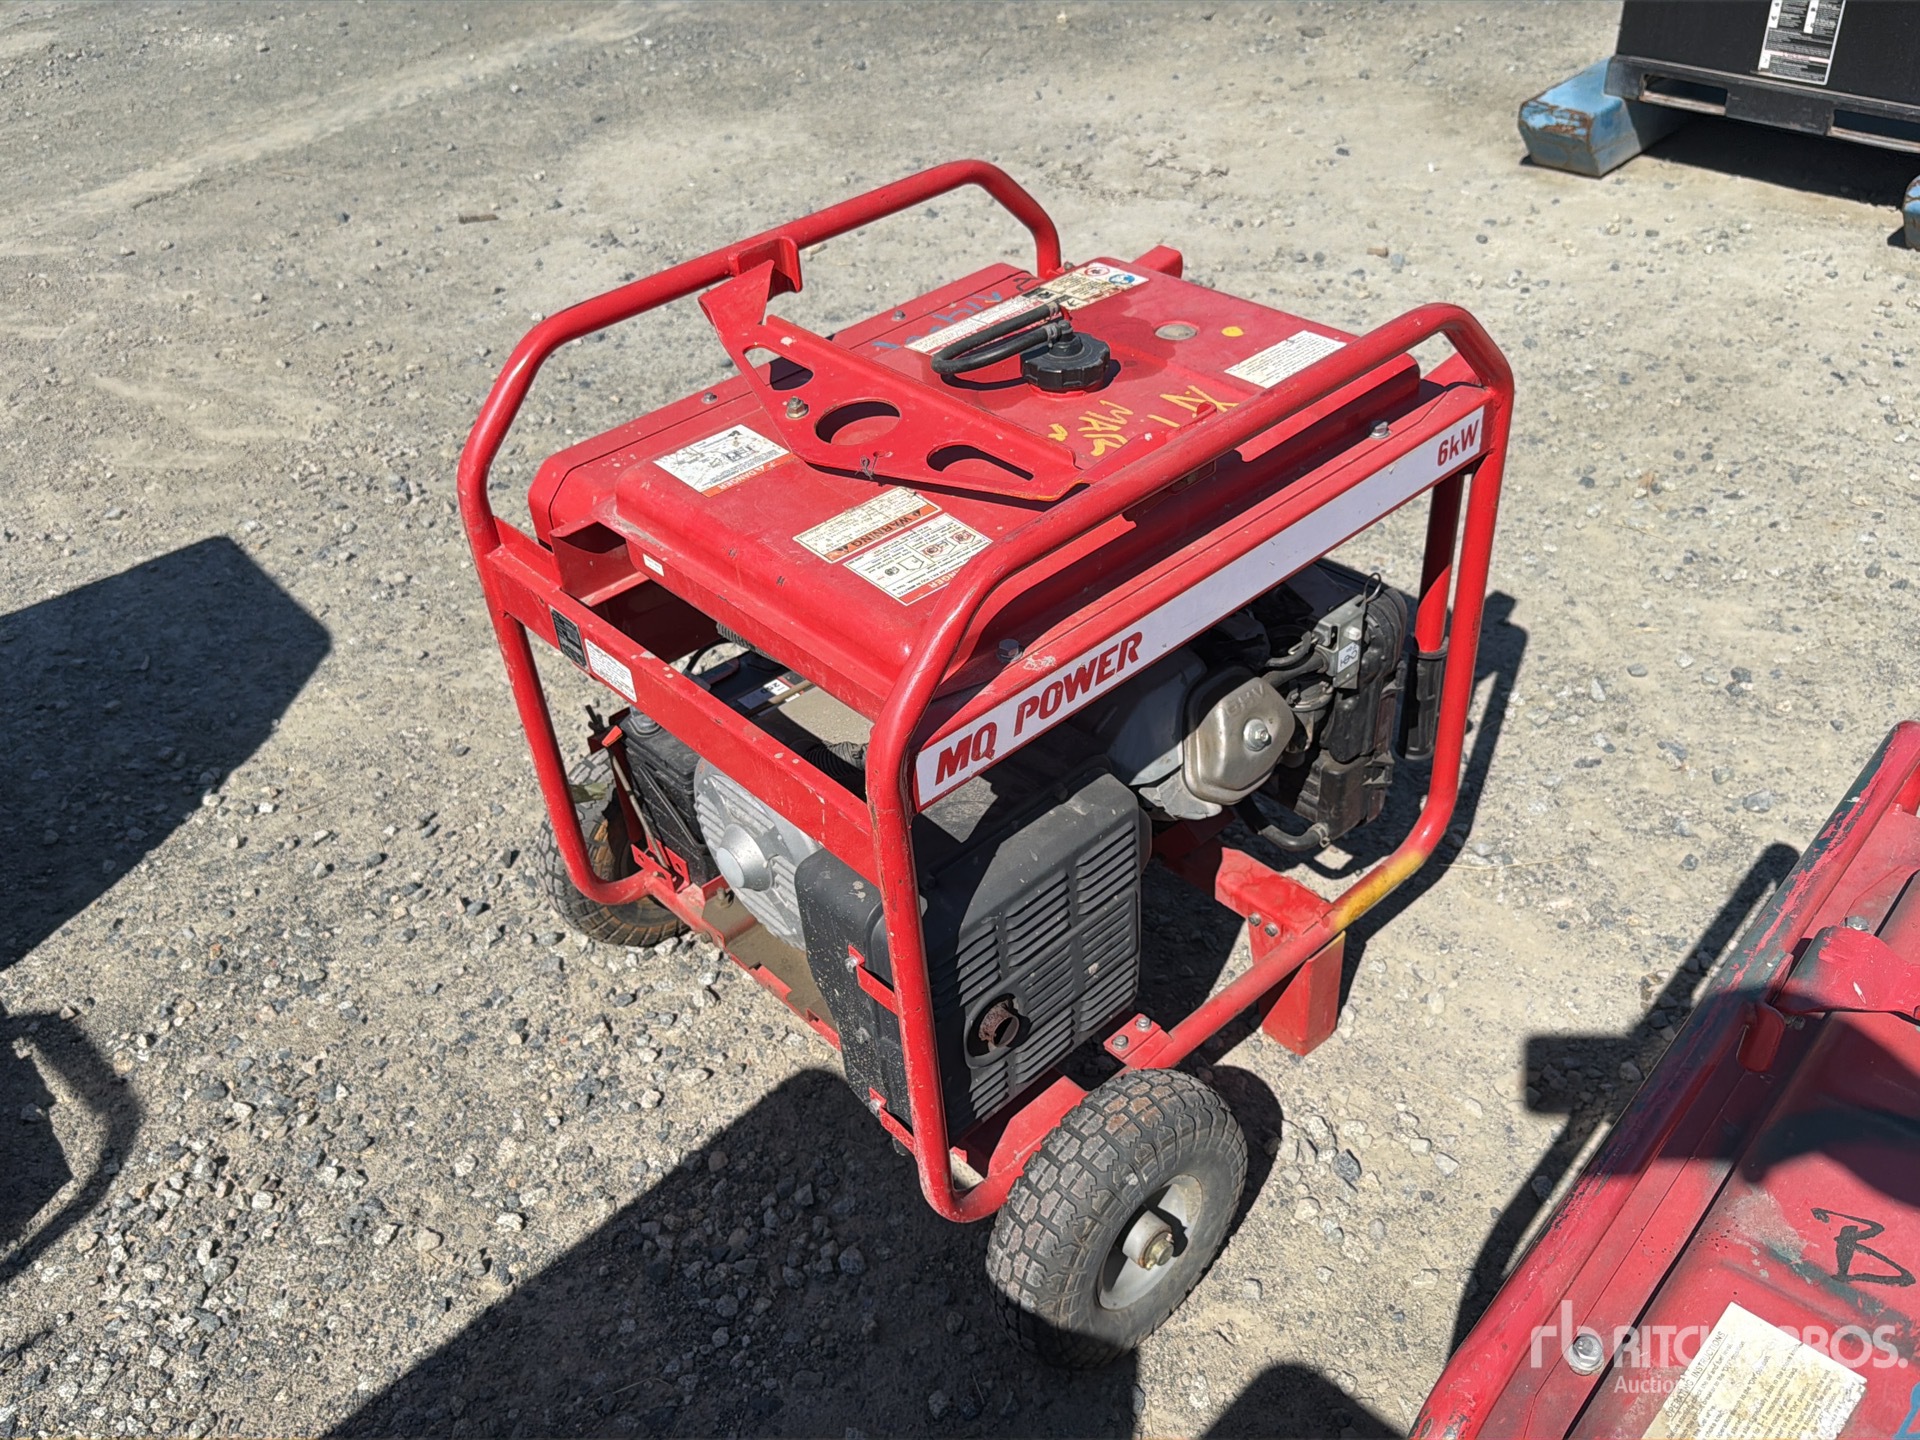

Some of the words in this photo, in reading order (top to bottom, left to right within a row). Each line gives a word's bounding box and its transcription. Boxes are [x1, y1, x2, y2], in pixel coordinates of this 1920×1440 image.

[1437, 419, 1480, 467] 6kW
[851, 510, 913, 548] WARNING
[935, 722, 998, 786] MQ
[1013, 631, 1143, 737] POWER
[1811, 1208, 1916, 1287] B
[1664, 1378, 1693, 1418] OPERATING
[1691, 1330, 1725, 1378] INSTRUCTIONS
[1708, 1363, 1718, 1374] and
[1742, 1385, 1751, 1394] the
